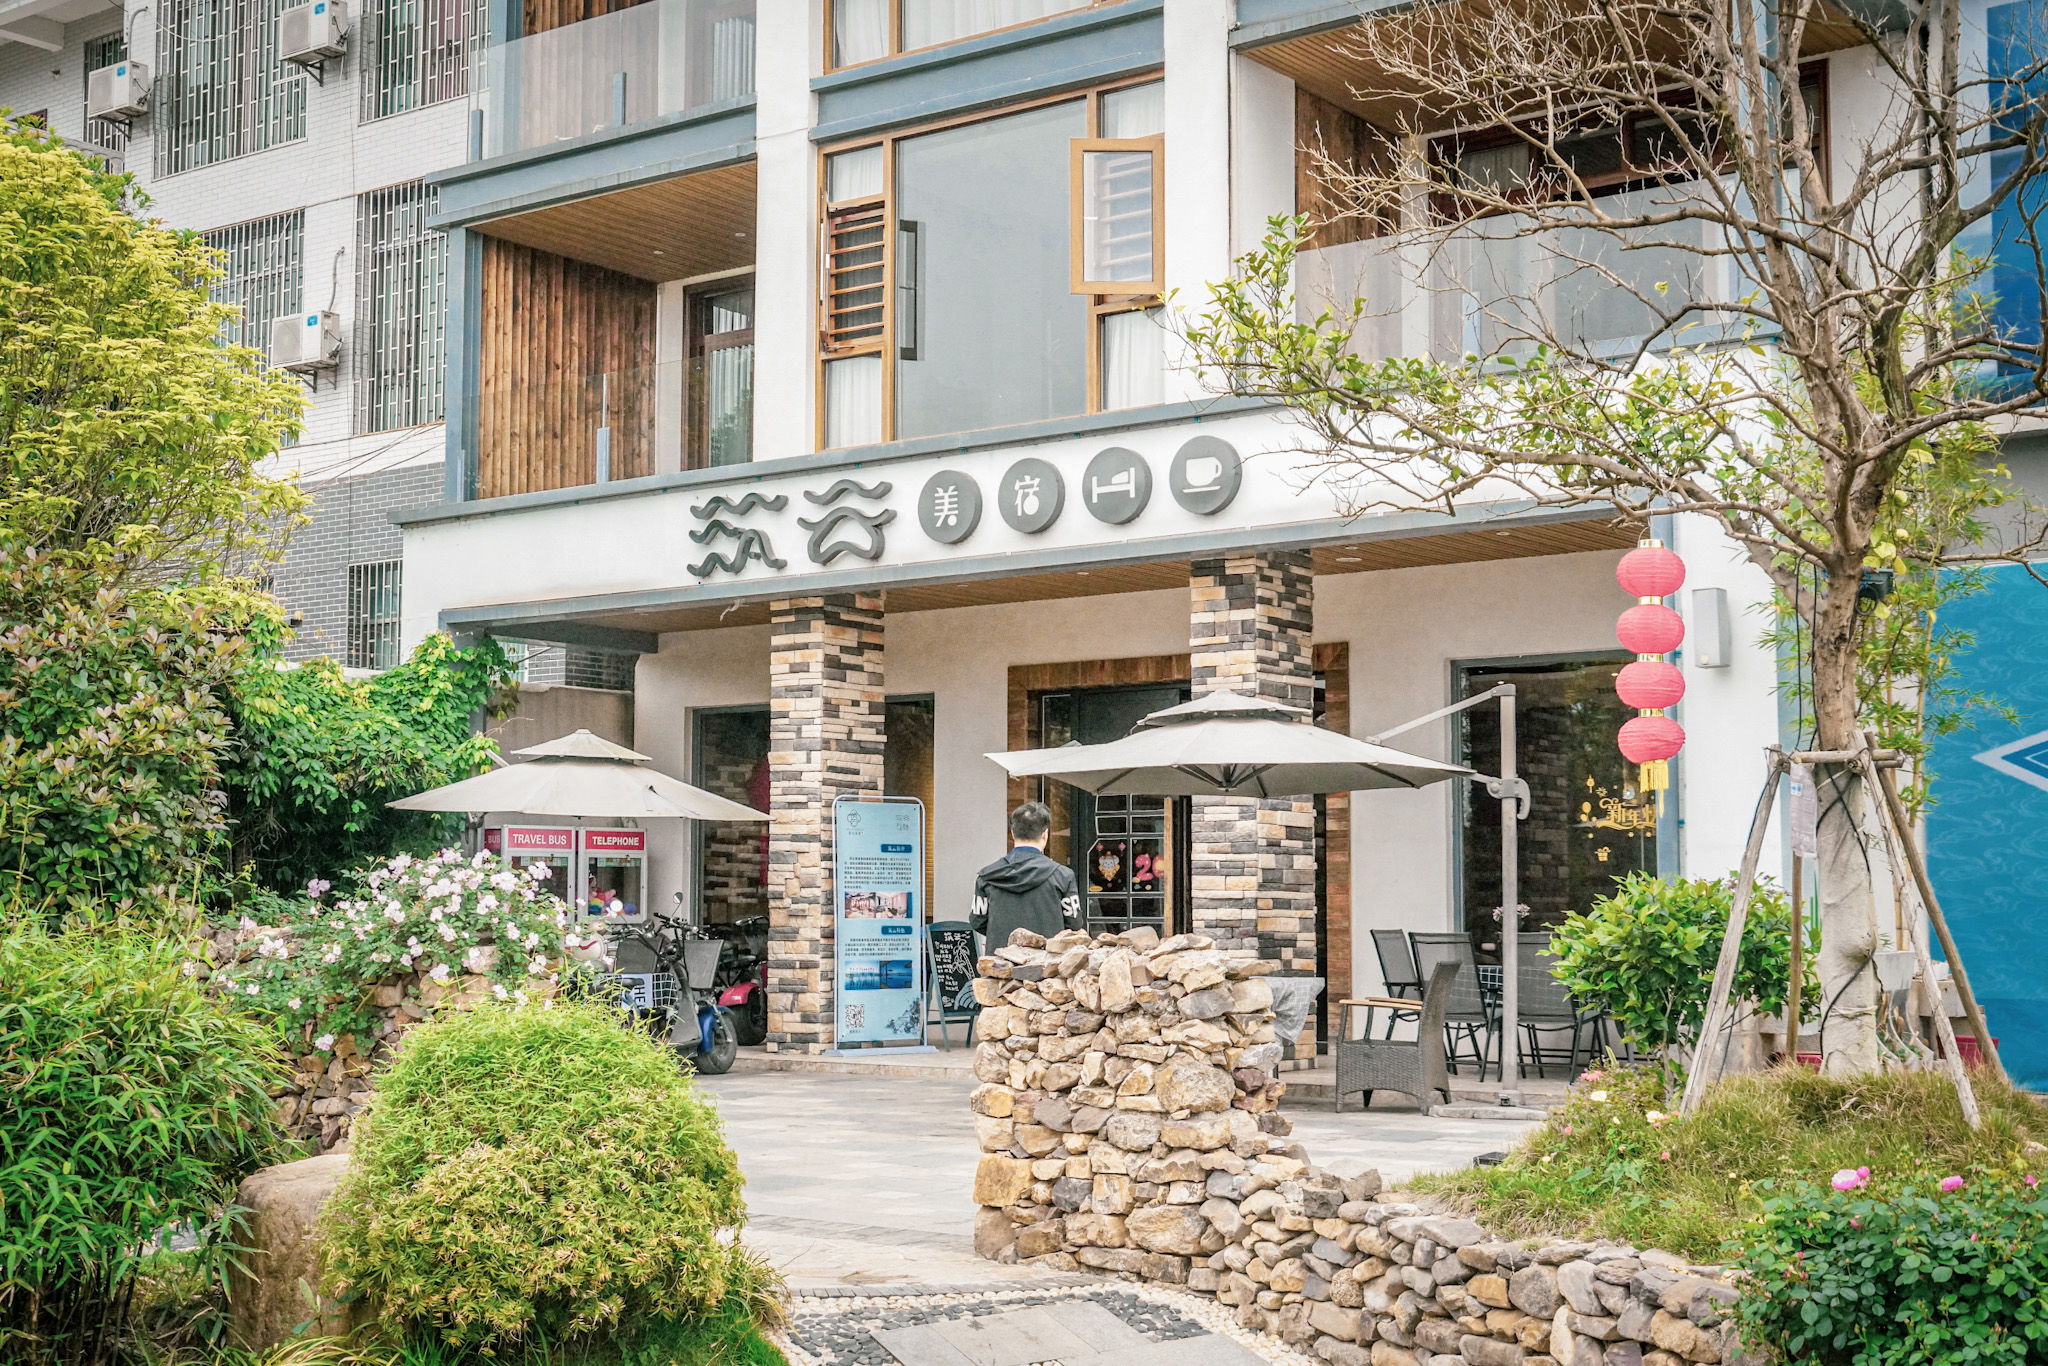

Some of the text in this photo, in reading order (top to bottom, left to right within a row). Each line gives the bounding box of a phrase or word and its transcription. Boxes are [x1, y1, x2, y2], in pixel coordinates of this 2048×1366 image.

[513, 833, 568, 846] TRAVEL BUS
[593, 836, 641, 846] TELEPHONE
